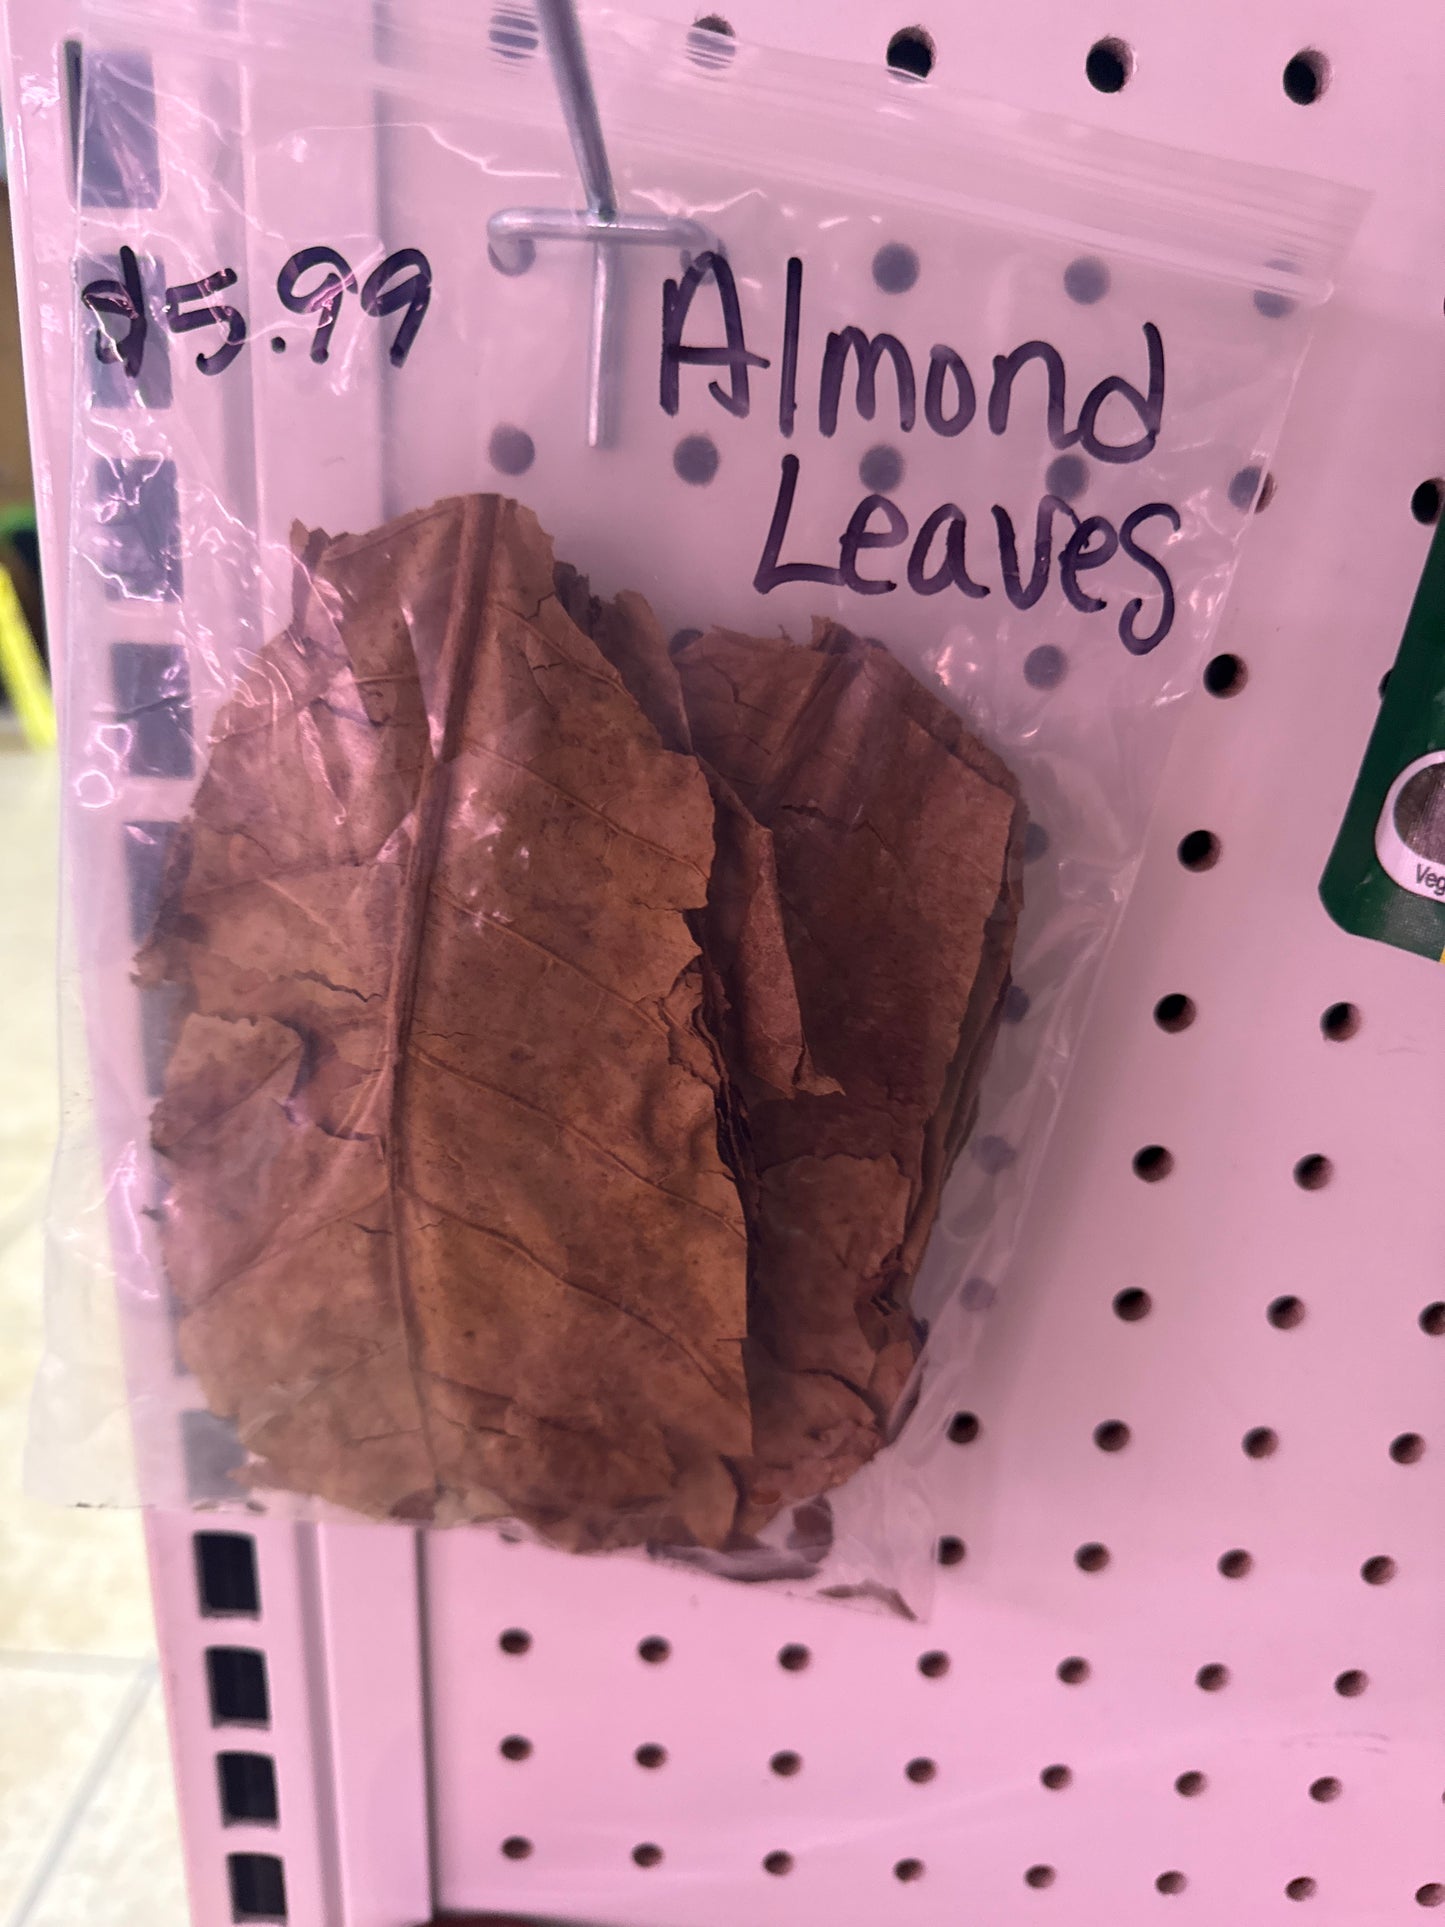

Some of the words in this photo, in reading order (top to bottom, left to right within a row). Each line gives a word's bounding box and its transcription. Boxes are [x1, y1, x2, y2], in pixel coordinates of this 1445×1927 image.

[82, 245, 433, 377] $5.99
[659, 250, 1166, 464] Almond
[753, 453, 1182, 656] Leaves
